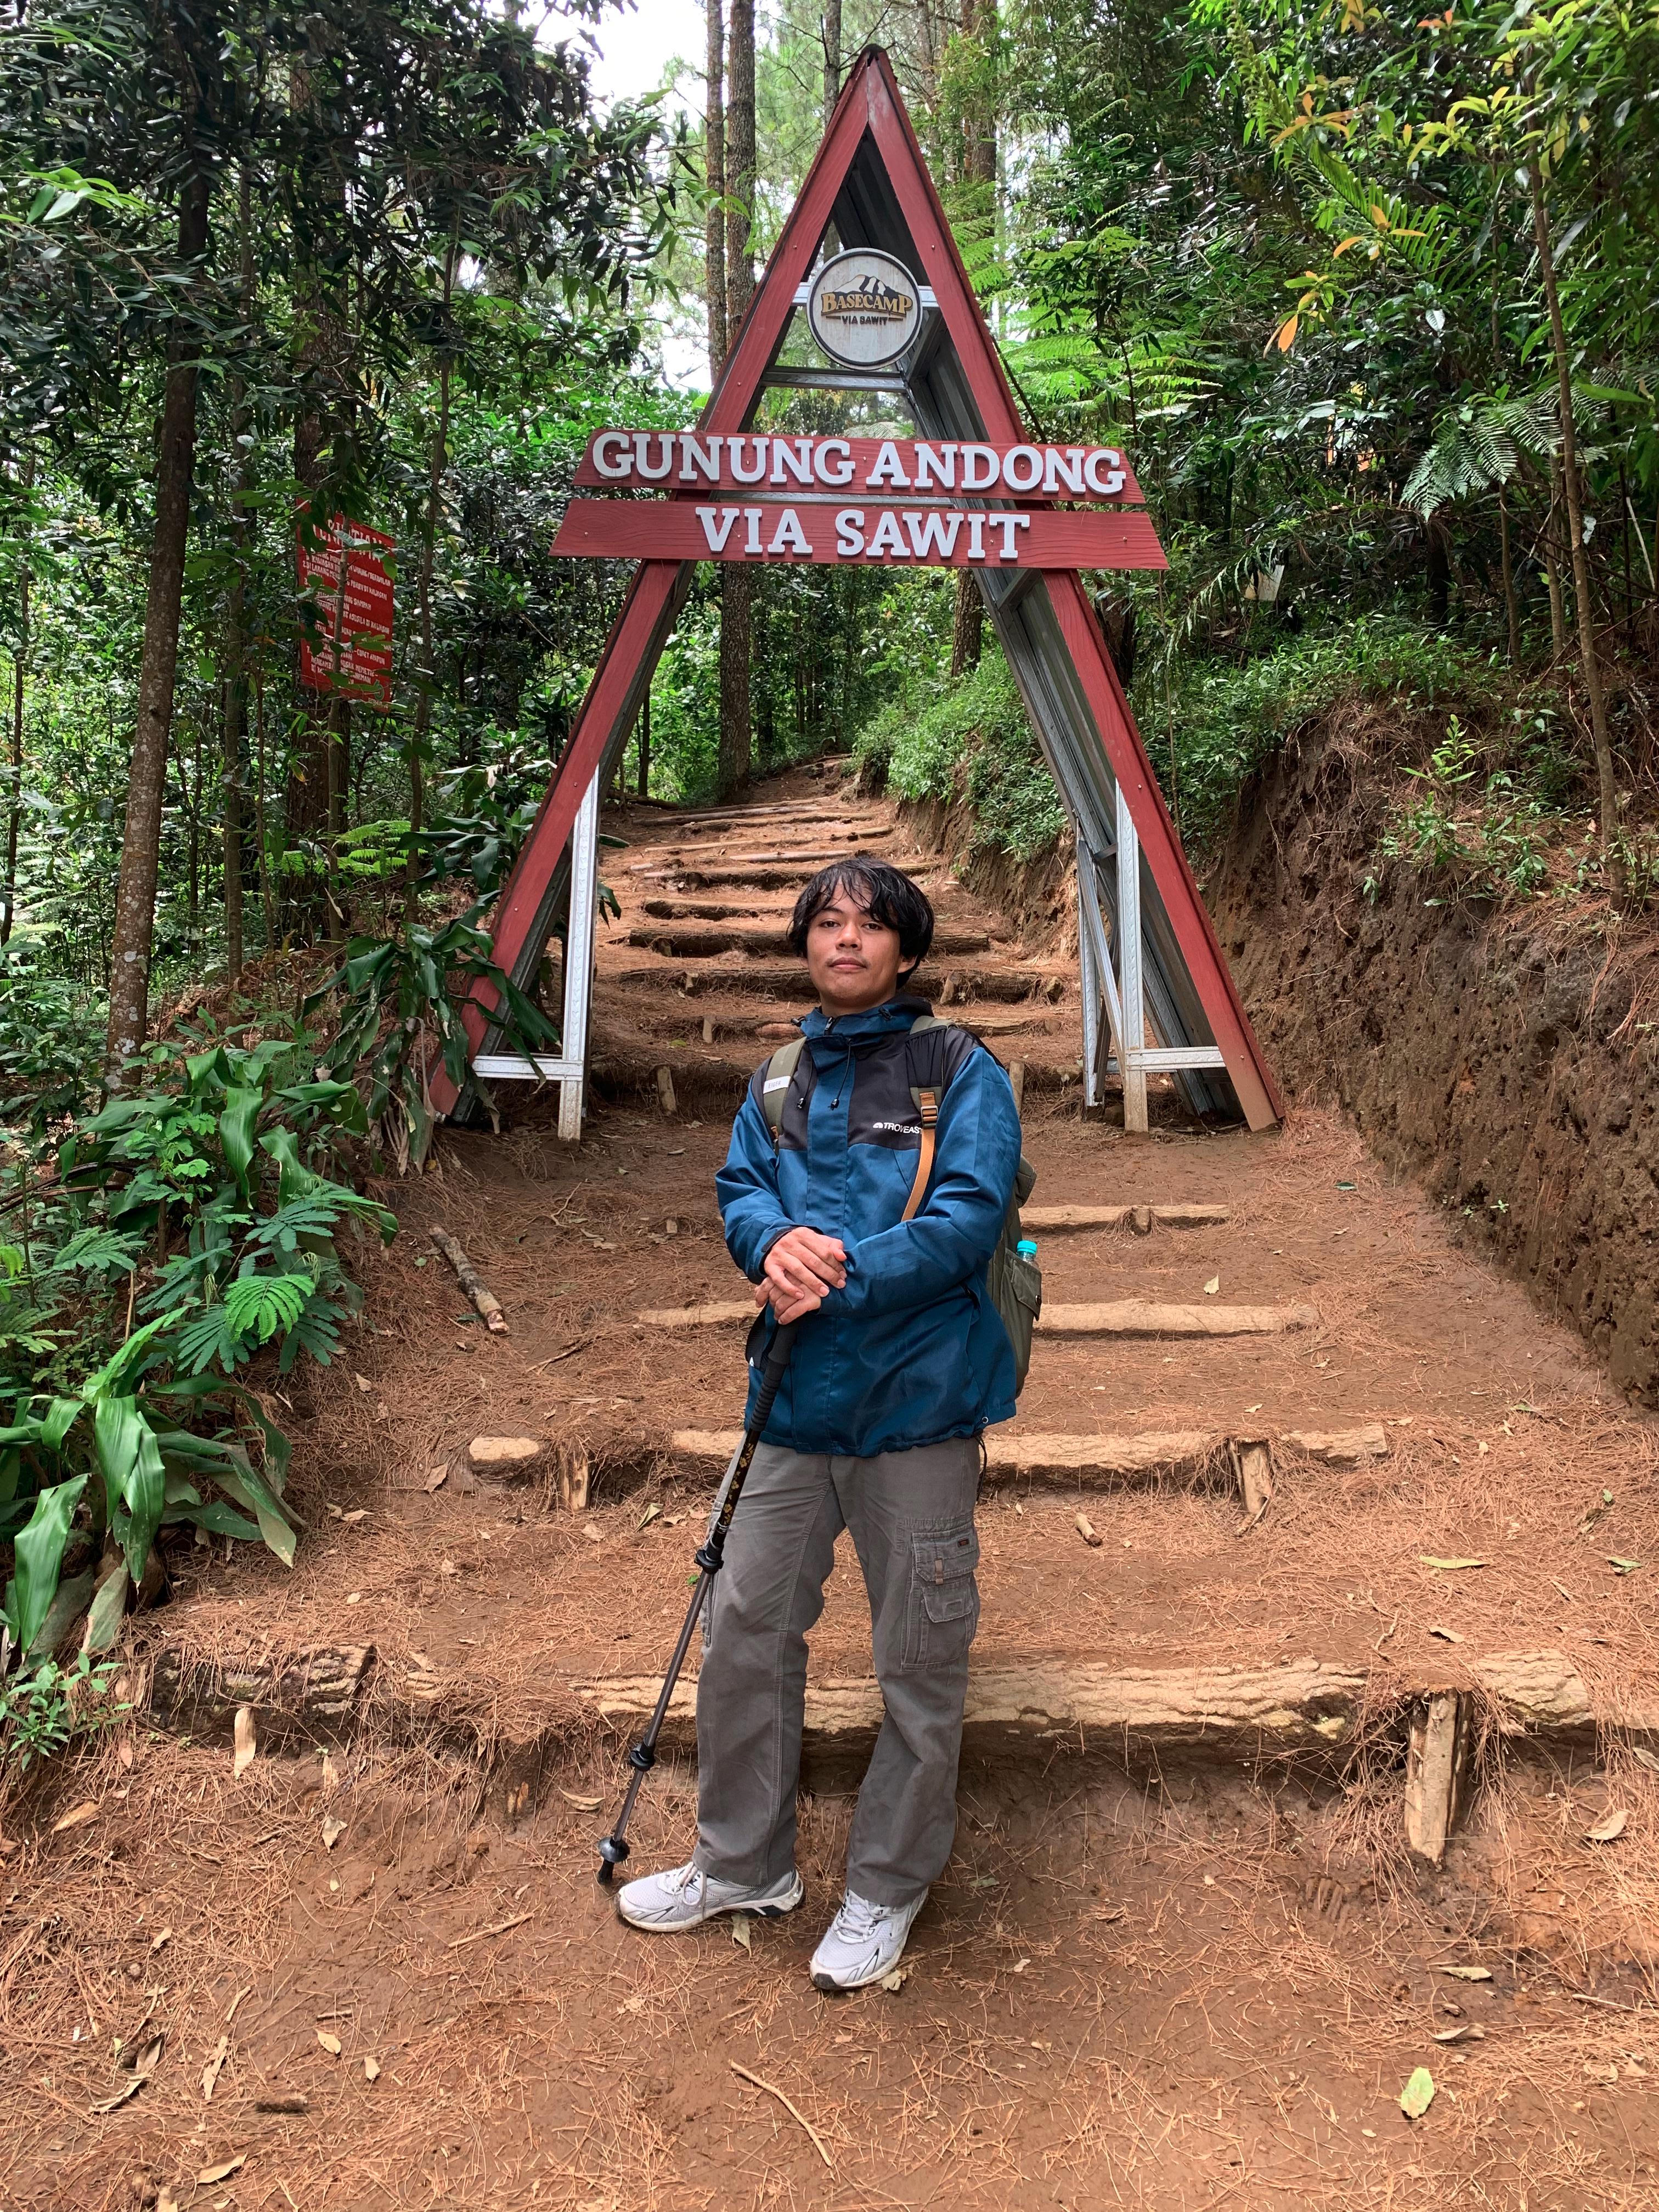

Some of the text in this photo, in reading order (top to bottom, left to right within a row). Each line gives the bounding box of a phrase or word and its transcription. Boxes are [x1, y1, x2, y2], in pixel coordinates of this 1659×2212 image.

[822, 292, 912, 315] BASECAMP
[842, 315, 889, 325] VIA SAWIT
[592, 431, 1126, 495] GUNUNG ANDONG
[696, 506, 1030, 560] VIA SAWIT
